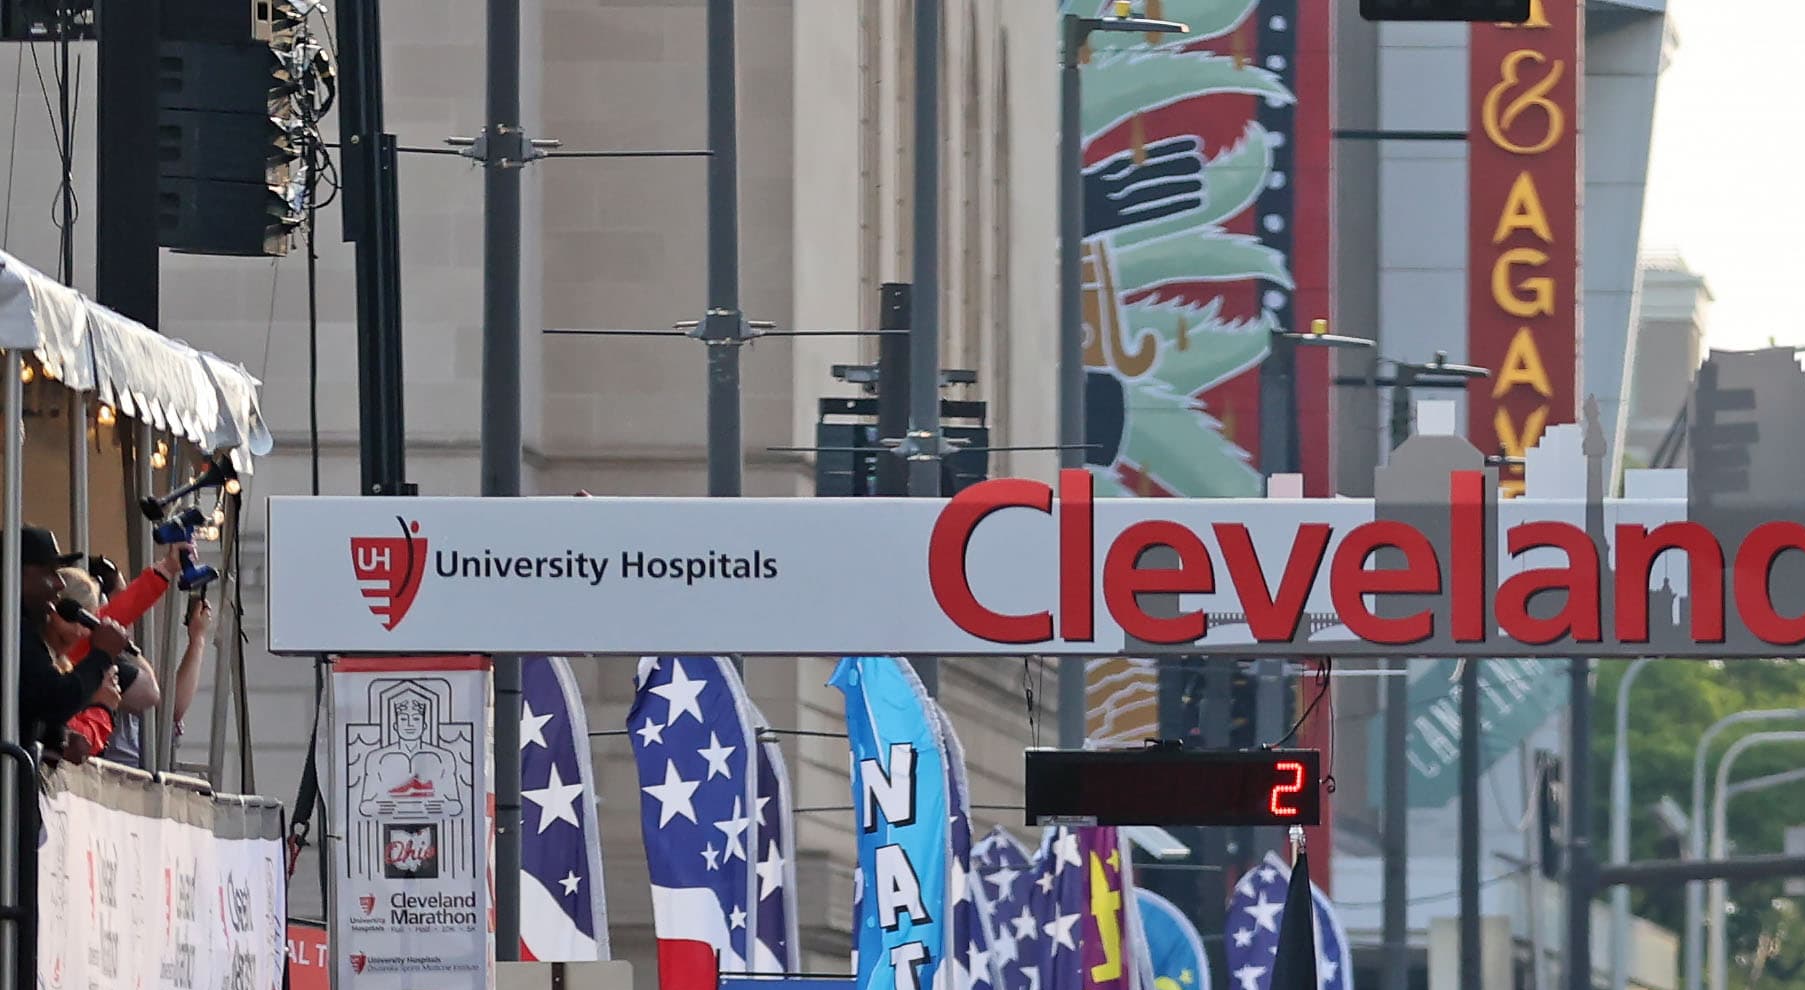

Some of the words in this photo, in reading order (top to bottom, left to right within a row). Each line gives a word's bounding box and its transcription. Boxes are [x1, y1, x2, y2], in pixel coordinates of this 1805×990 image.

[1482, 49, 1564, 154] &
[435, 549, 608, 585] University
[621, 550, 778, 585] Hospitals
[1270, 762, 1304, 815] 2
[384, 838, 437, 864] Ohio
[391, 891, 476, 908] Cleveland
[391, 909, 476, 925] Marathon
